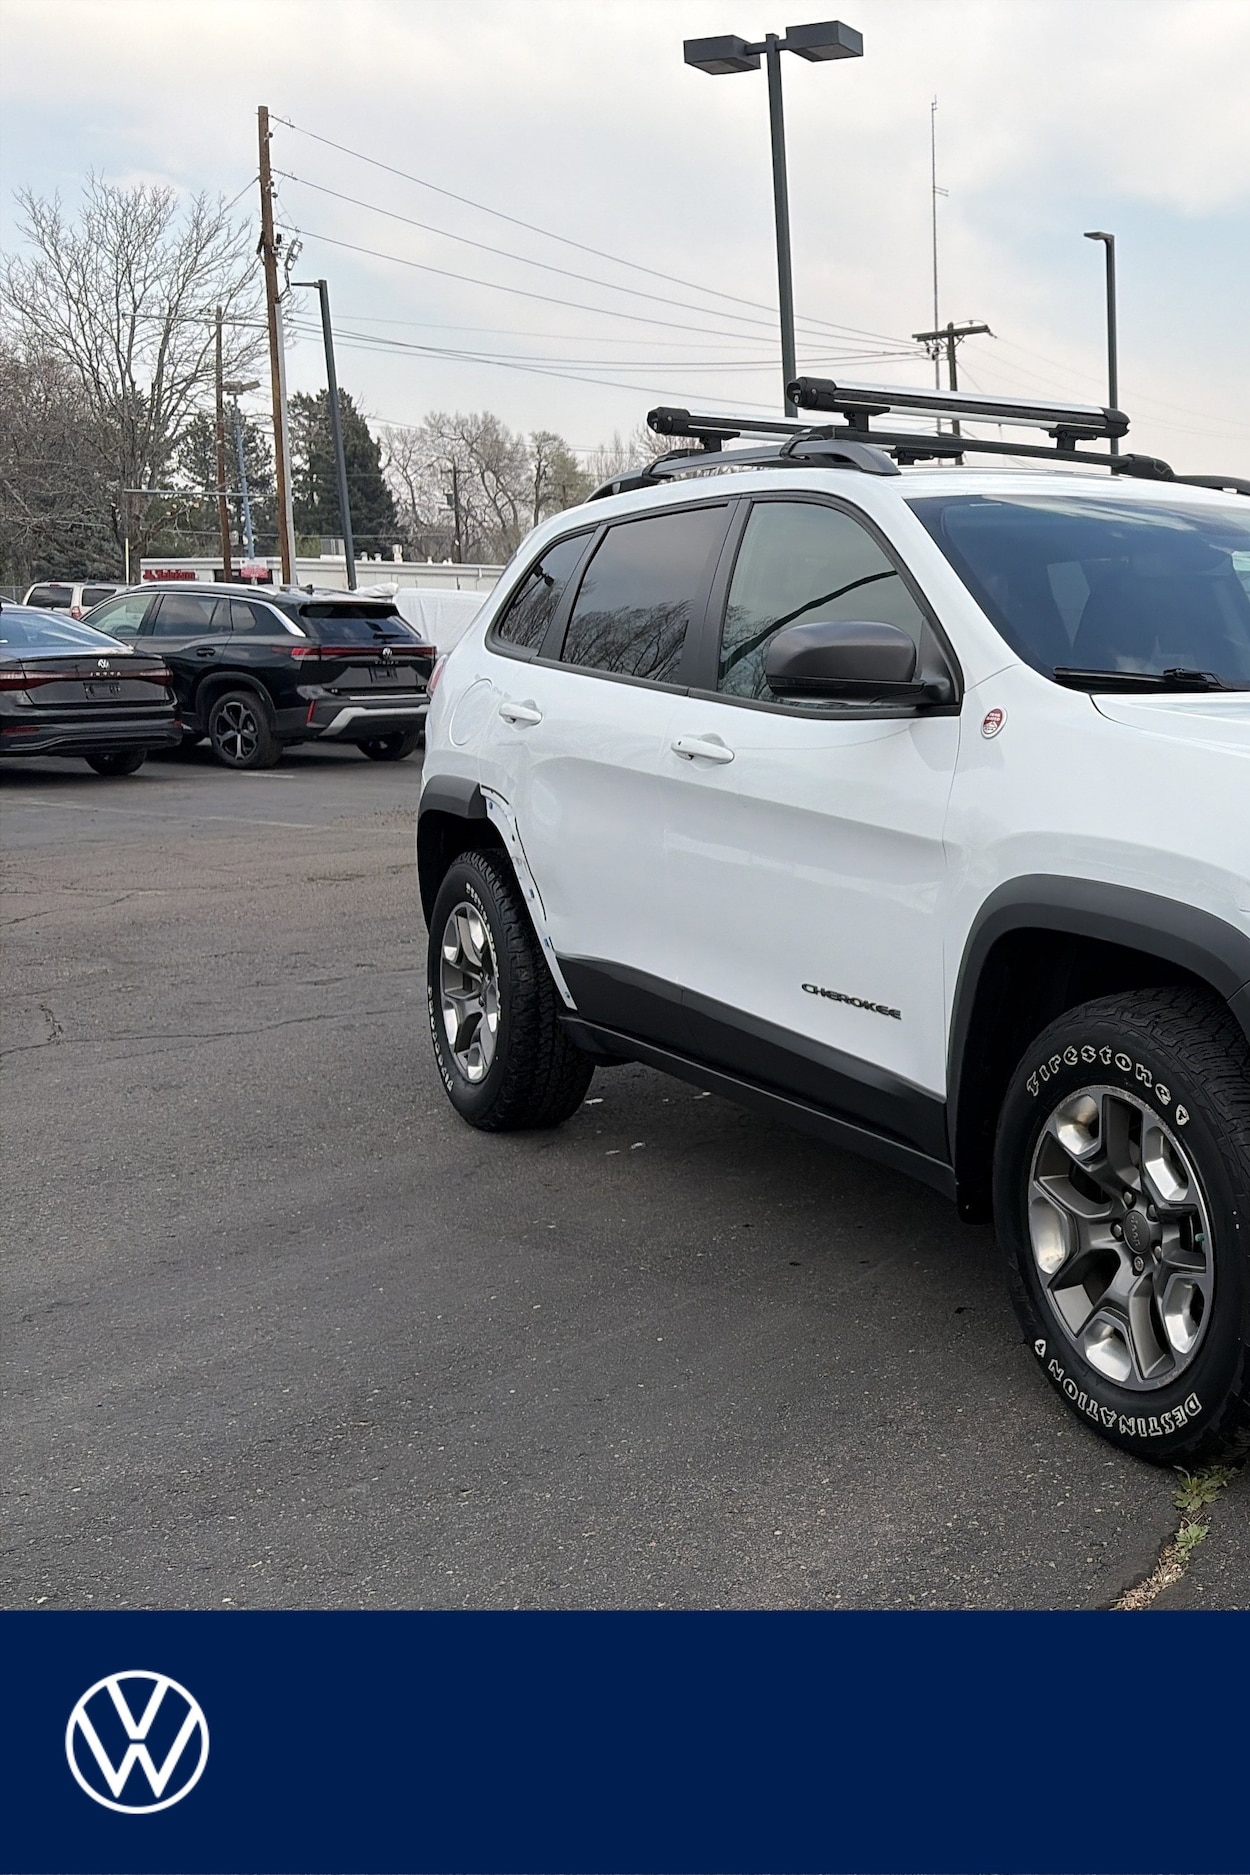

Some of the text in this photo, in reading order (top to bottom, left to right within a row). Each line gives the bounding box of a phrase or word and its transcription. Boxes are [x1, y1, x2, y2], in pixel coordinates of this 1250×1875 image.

[801, 983, 902, 1020] CHEROKEE
[1026, 1045, 1171, 1105] Firestone
[1048, 1359, 1202, 1437] DESTINATION
